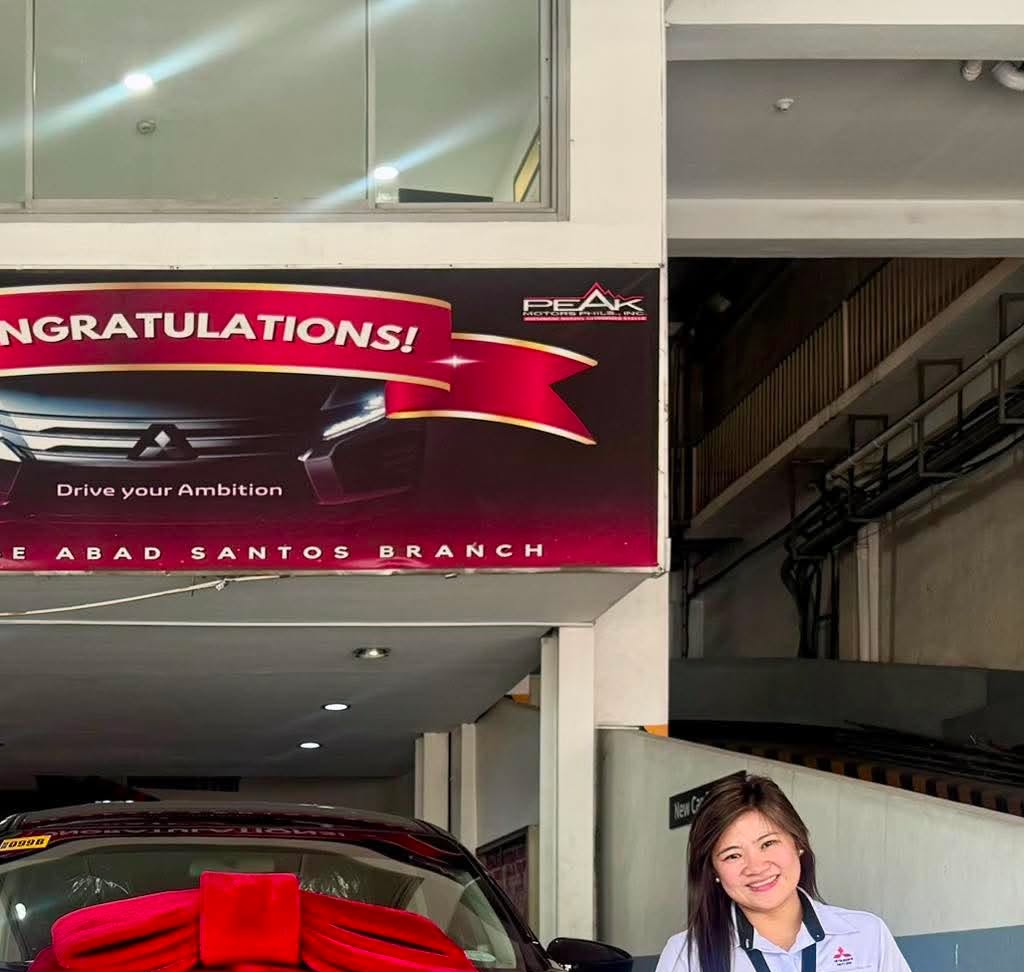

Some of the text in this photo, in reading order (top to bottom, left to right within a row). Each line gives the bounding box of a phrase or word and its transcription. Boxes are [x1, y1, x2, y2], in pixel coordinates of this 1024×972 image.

[523, 288, 644, 312] PEAK
[57, 483, 283, 500] Drive your Ambition
[55, 546, 161, 560] ABAD
[191, 545, 349, 560] SANTOS
[379, 543, 543, 559] BRANCH
[673, 800, 690, 820] New
